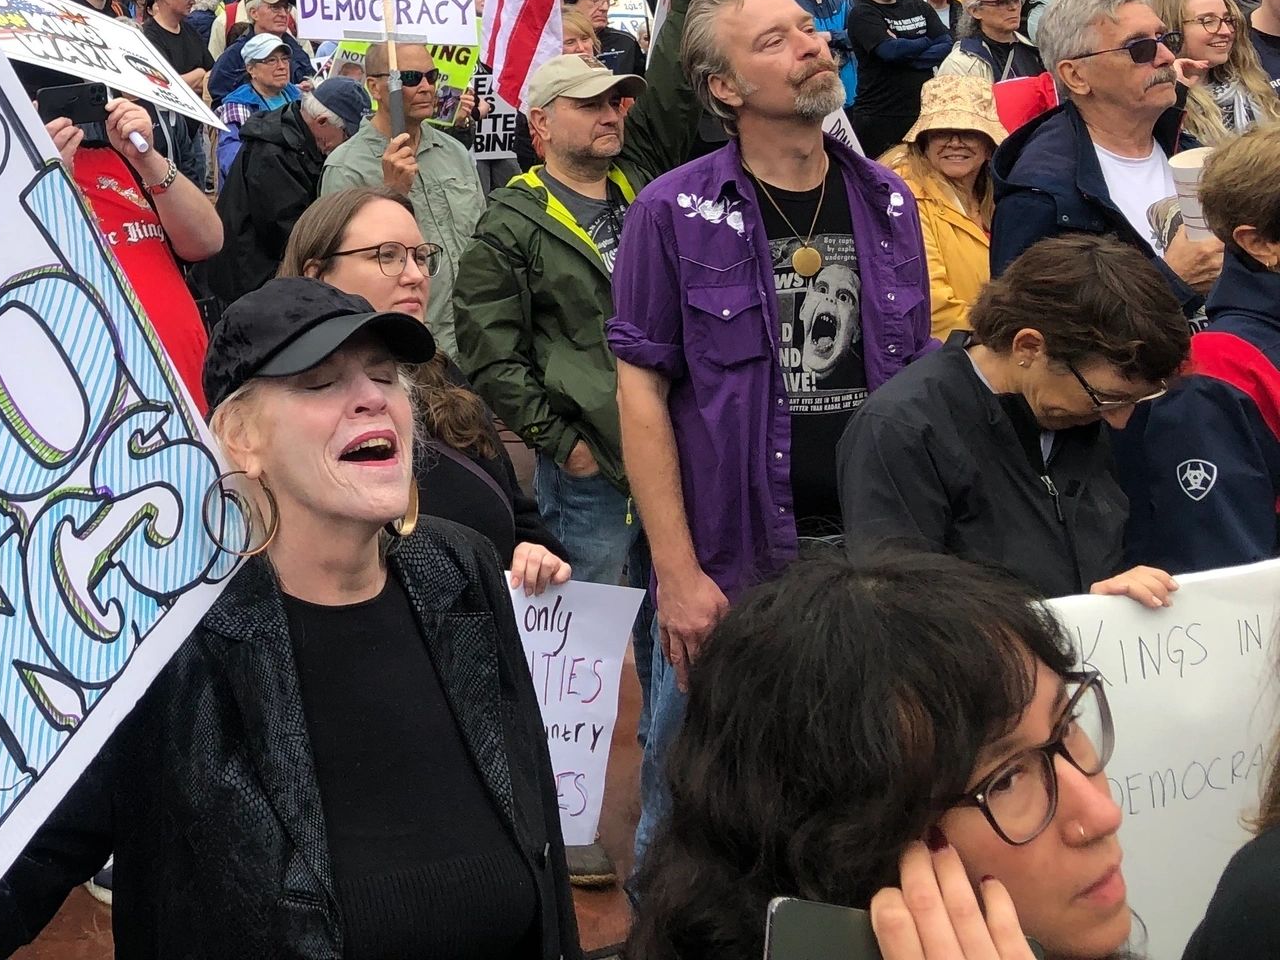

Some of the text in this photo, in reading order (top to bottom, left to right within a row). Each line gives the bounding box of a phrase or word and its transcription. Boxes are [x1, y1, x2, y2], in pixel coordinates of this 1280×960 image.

[523, 594, 573, 656] only
[1076, 614, 1262, 687] KINGS IN
